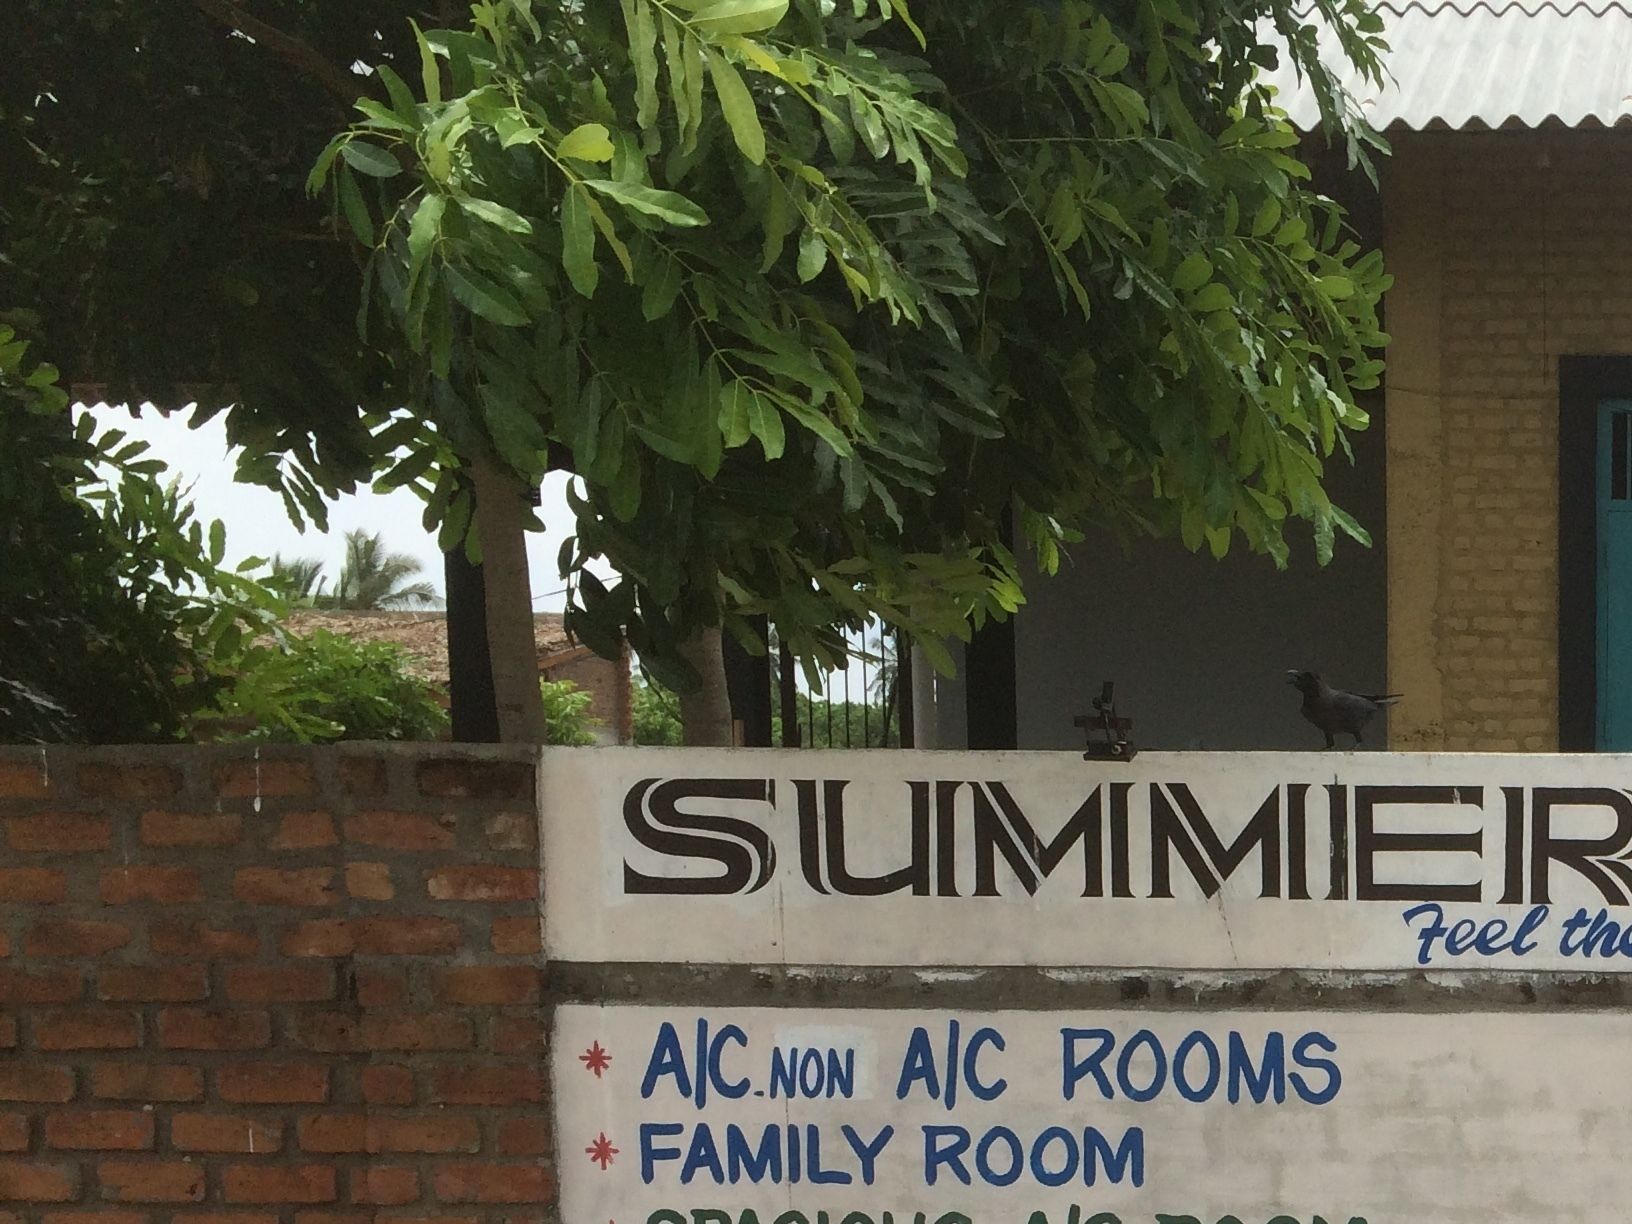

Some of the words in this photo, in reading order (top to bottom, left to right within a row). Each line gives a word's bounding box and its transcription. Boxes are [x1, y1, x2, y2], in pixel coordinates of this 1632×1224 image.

[1403, 903, 1550, 963] Feel
[897, 1020, 1007, 1110] A/C
[1060, 1028, 1341, 1105] ROOMS
[640, 1123, 894, 1185] FAMILY
[922, 1126, 1144, 1187] ROOM
